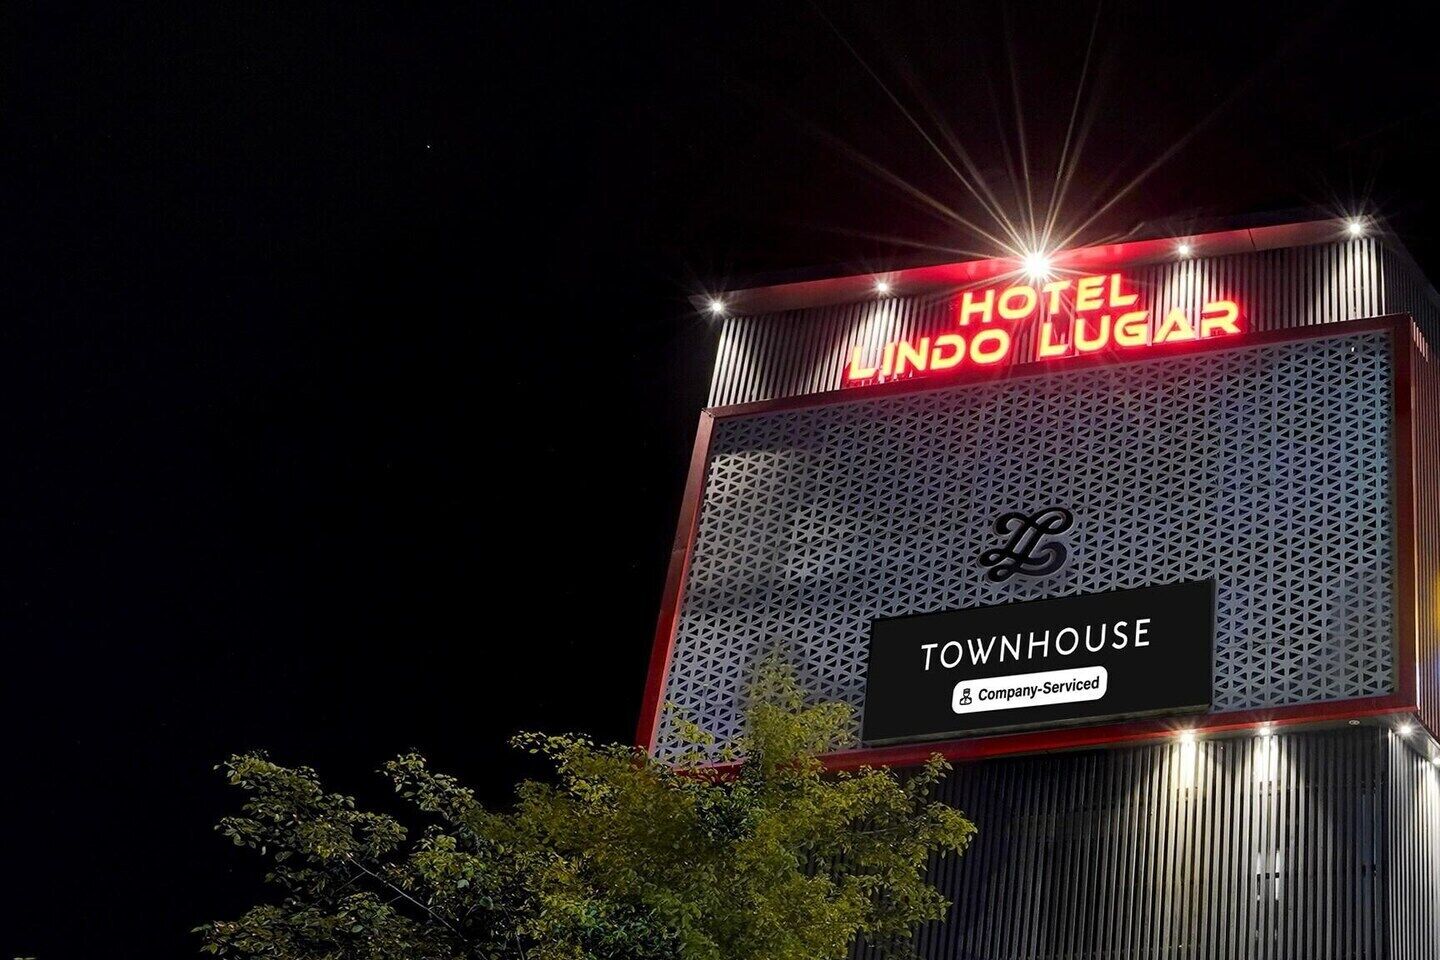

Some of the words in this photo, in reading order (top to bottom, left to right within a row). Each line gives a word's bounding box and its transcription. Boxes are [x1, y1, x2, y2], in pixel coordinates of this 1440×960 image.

[959, 273, 1139, 326] HOTEL
[848, 328, 1011, 380] LINDO
[1039, 300, 1241, 358] LUGAR
[921, 618, 1150, 671] TOWNHOUSE
[978, 676, 1100, 701] Company-Serviced
